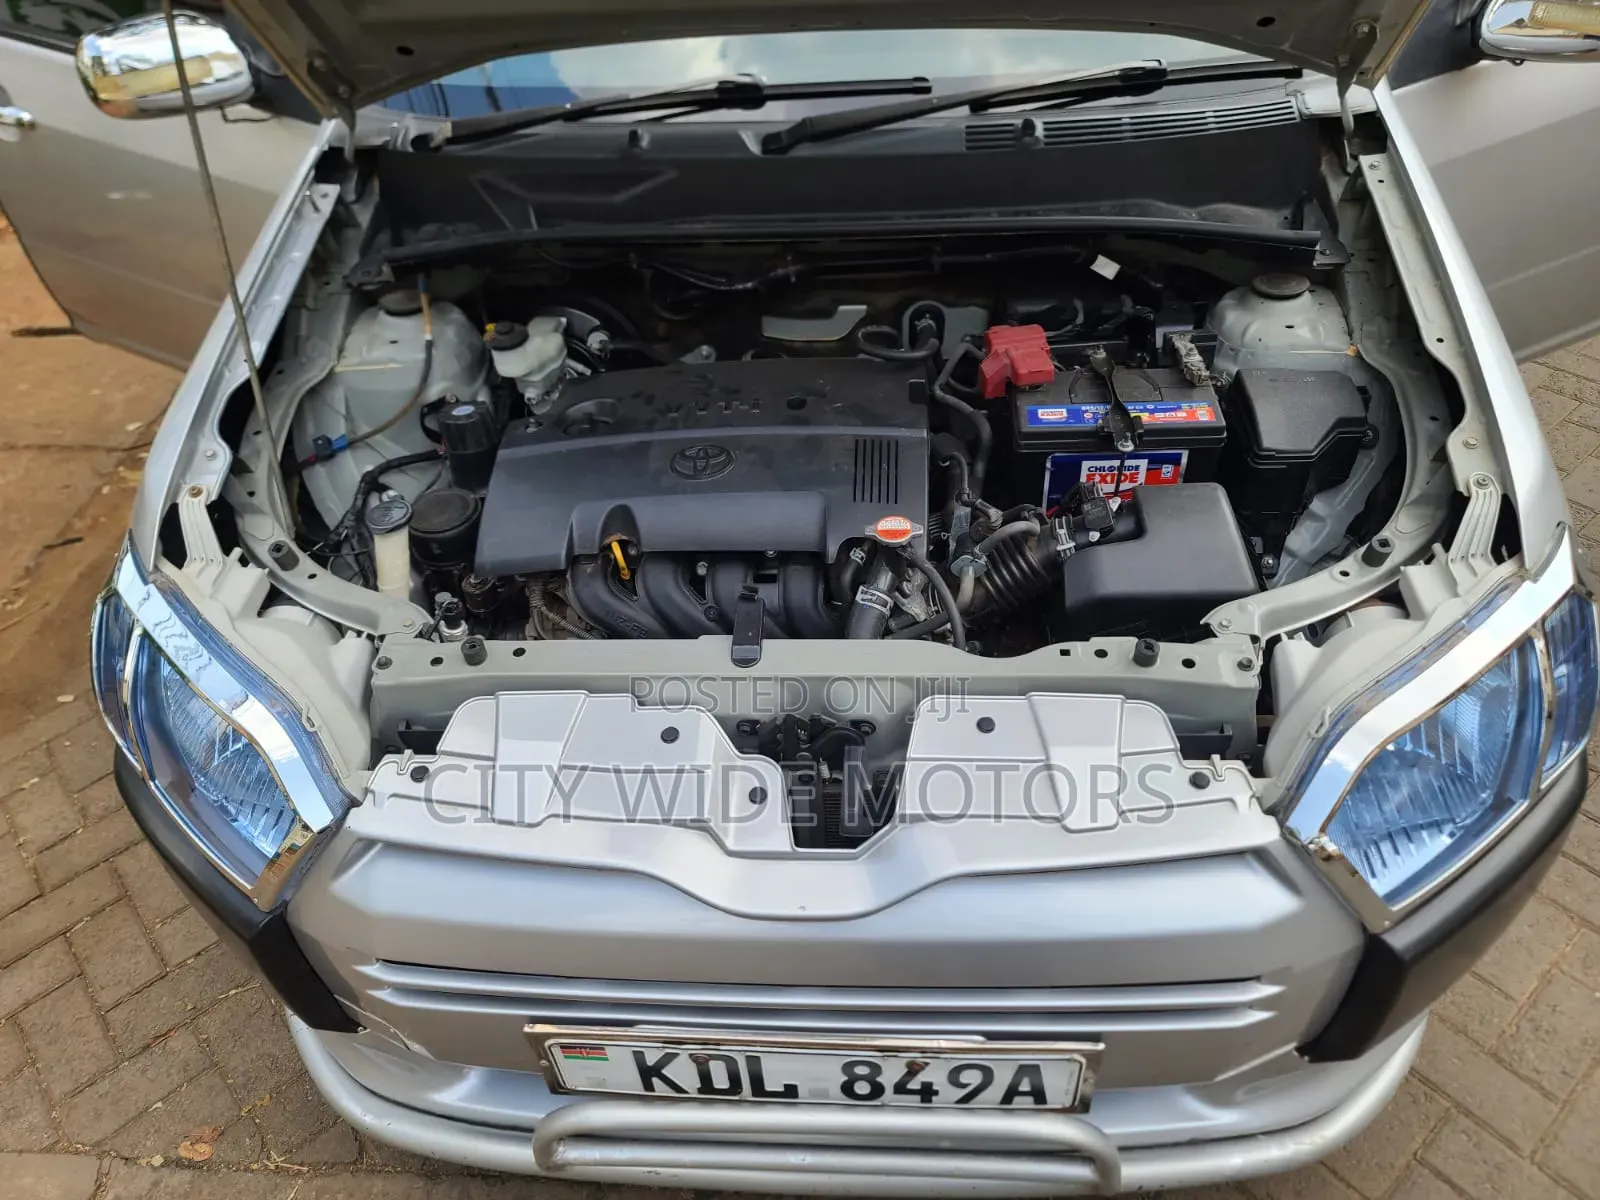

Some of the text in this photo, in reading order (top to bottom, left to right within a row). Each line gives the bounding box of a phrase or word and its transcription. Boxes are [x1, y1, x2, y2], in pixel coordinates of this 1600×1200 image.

[1087, 465, 1140, 473] CHLOIDE
[632, 1050, 799, 1099] KDL
[840, 1060, 1048, 1105] 849A
